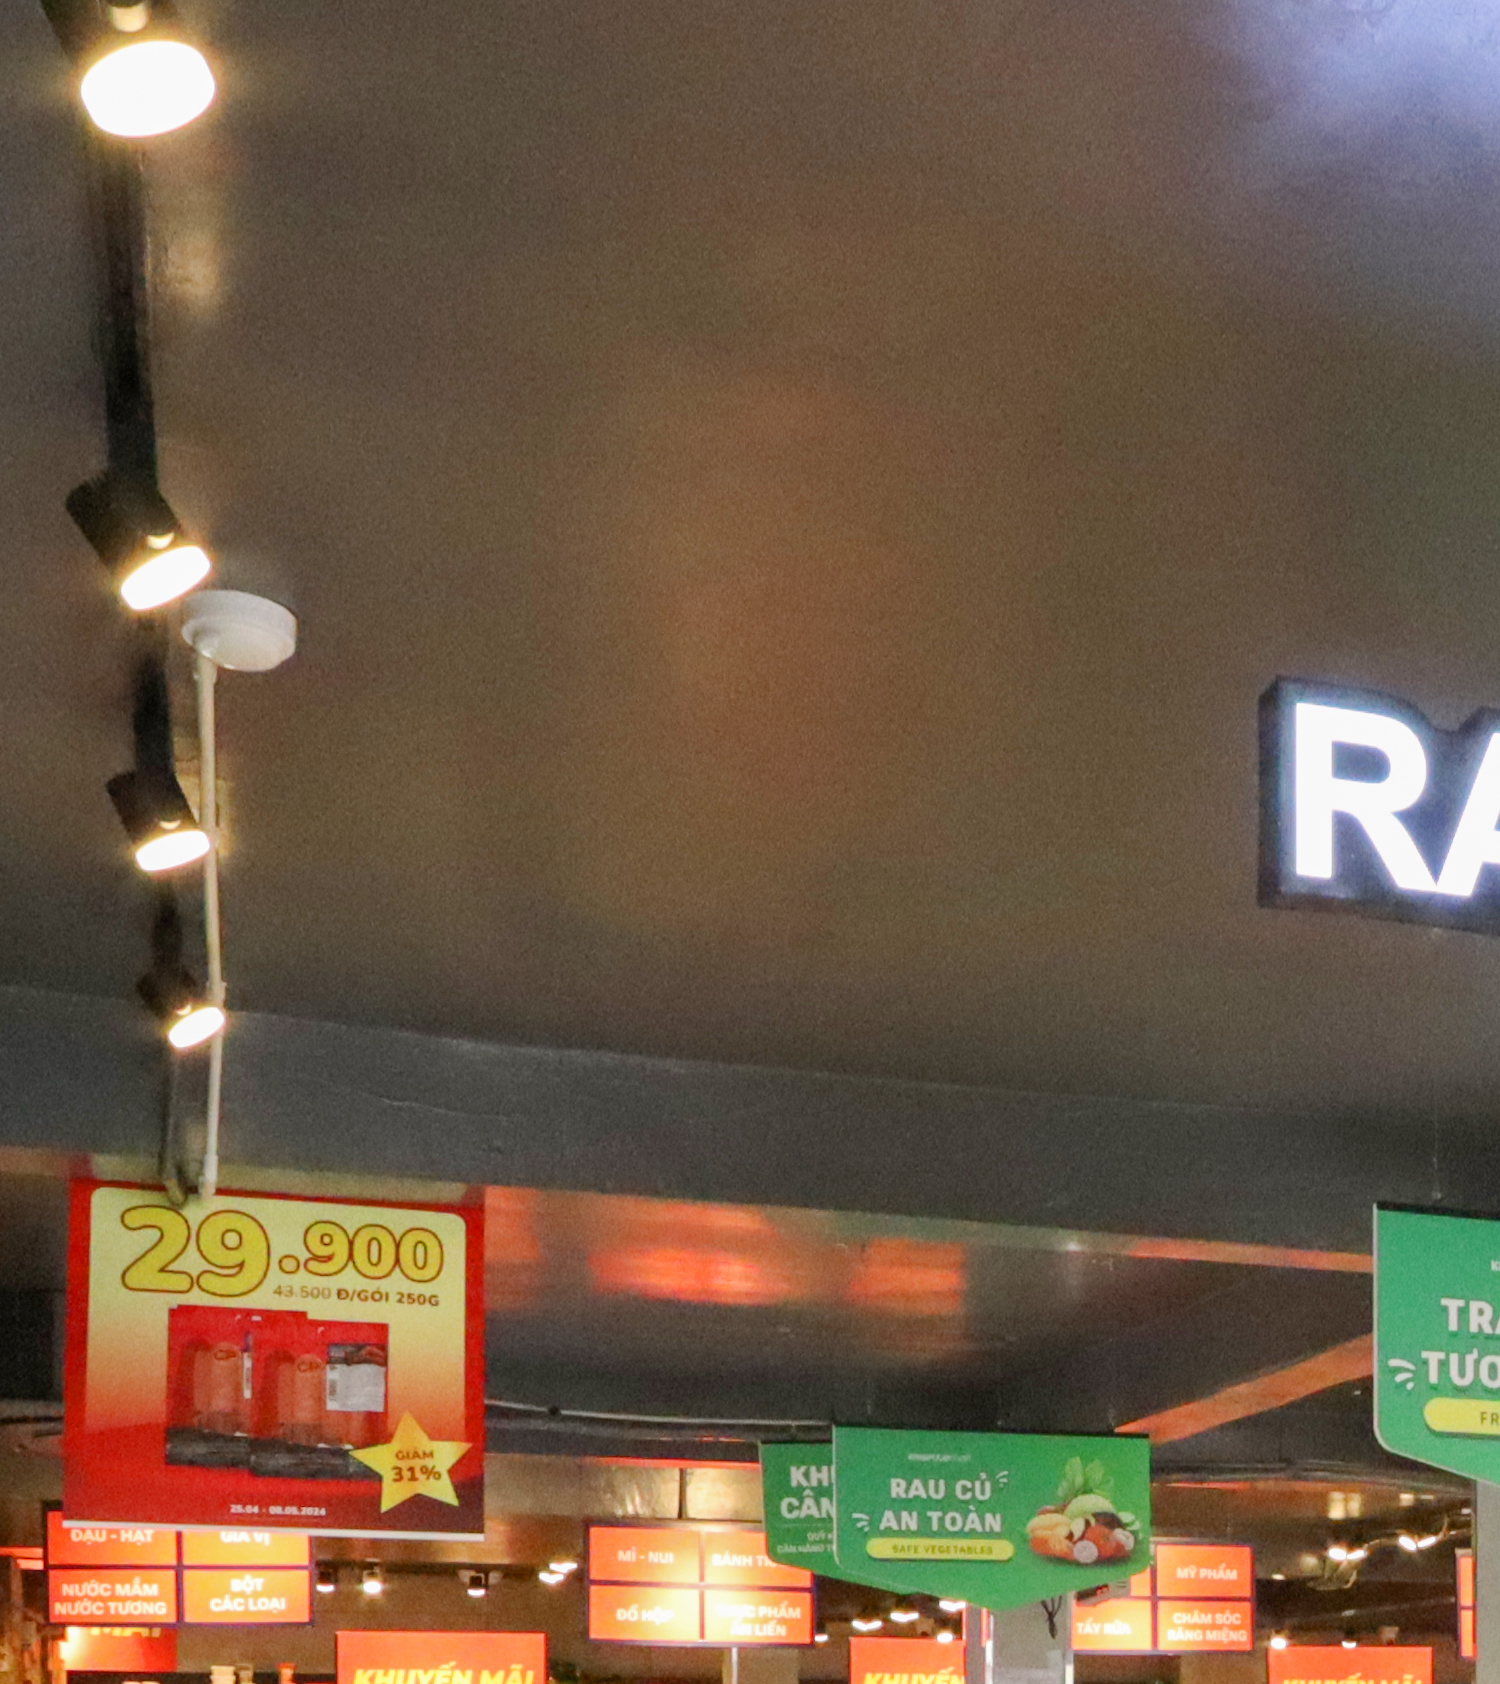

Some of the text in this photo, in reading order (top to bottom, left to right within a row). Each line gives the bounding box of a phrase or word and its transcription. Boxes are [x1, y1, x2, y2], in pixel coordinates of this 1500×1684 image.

[120, 1205, 445, 1298] 29.900
[273, 1285, 440, 1307] 43.500 Đ/GÓI 250G
[391, 1465, 442, 1483] 31%
[890, 1472, 992, 1501] RAU CỦ
[230, 1504, 326, 1517] 25.04 08.05.2024
[879, 1505, 1001, 1533] AN TOÀN
[121, 1529, 155, 1545] HẠT
[648, 1552, 674, 1564] NUI
[892, 1544, 993, 1555] SAFE VEGETABLES
[711, 1551, 753, 1567] BÁNH
[1199, 1563, 1238, 1580] PHẨM
[62, 1577, 159, 1597] NƯỚC MẮM
[231, 1574, 265, 1595] BỘT
[54, 1599, 167, 1616] NƯỚC TƯƠNG
[210, 1595, 286, 1614] CÁC LOẠI
[1172, 1610, 1242, 1625] CHĂM SÓC
